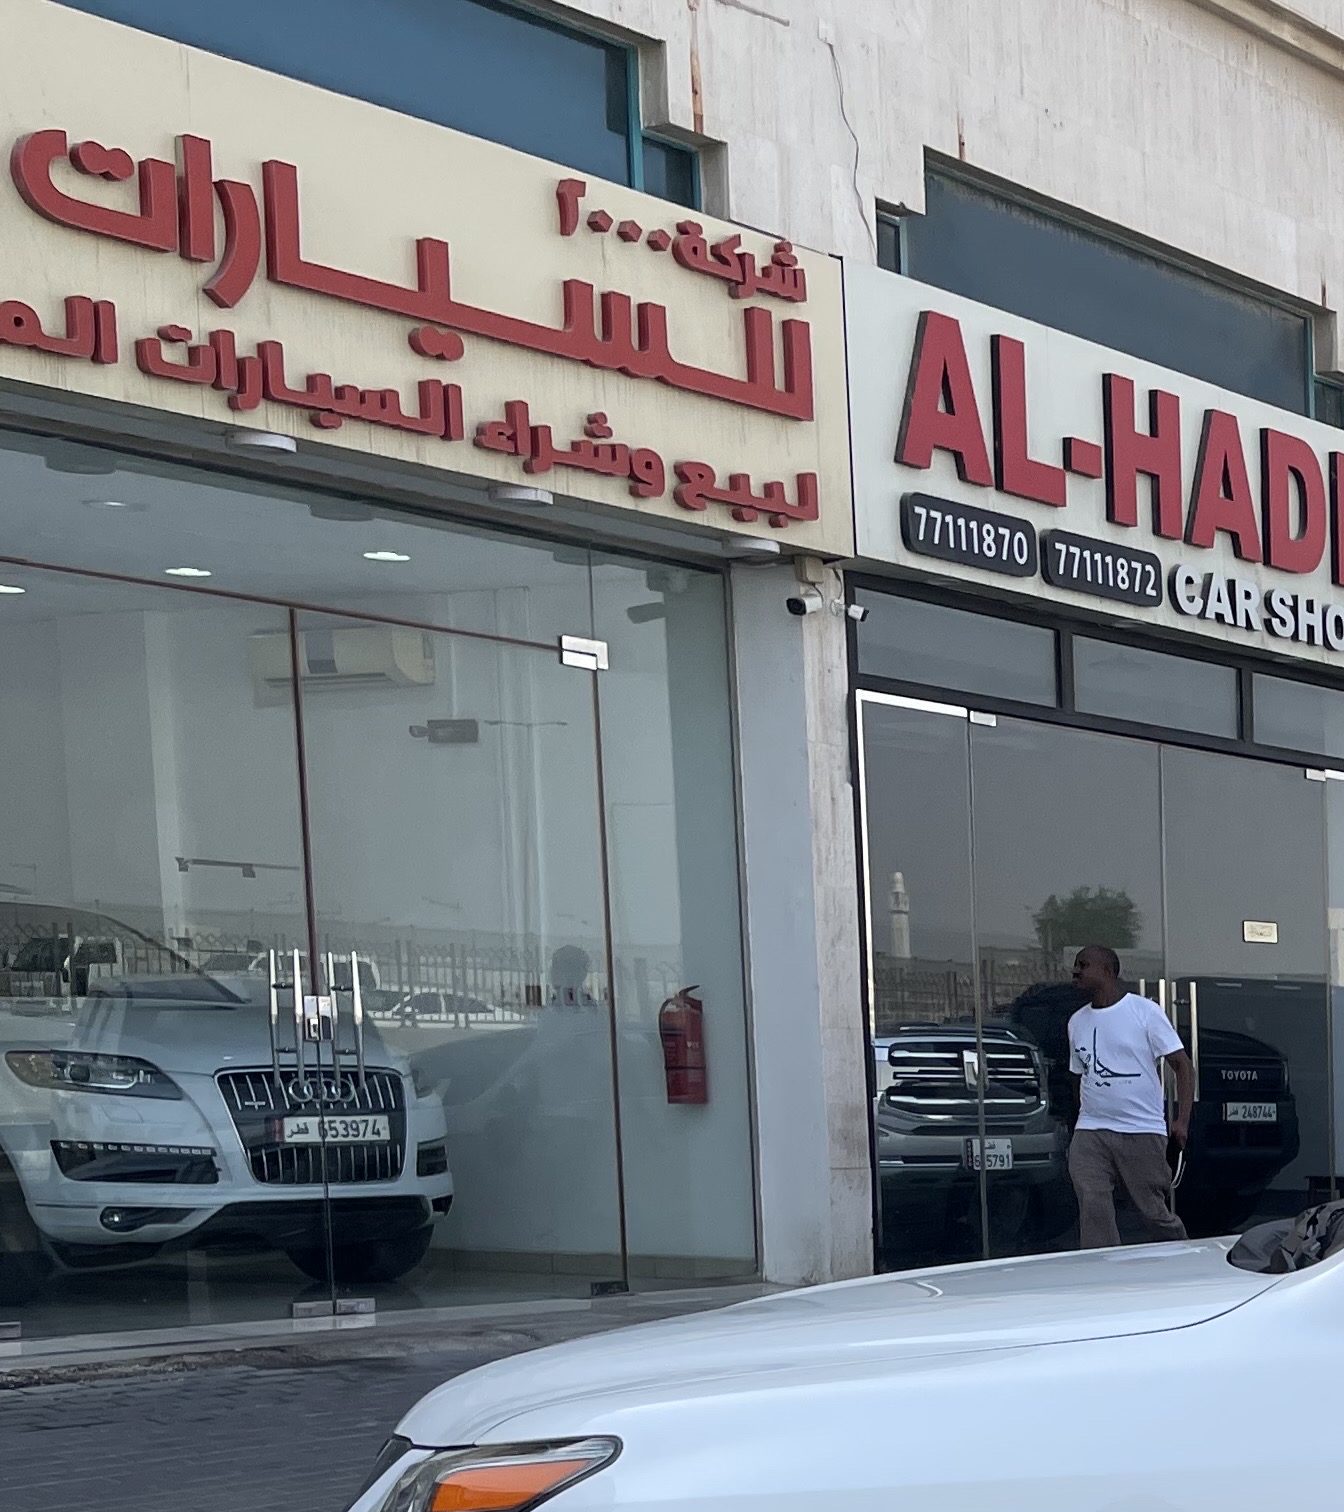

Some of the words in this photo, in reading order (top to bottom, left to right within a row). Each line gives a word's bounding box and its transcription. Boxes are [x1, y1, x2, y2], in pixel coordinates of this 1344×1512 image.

[10, 128, 816, 423] للسيارات
[672, 219, 808, 303] شركة
[135, 323, 464, 443] السيارات
[474, 400, 665, 499] وشراء
[673, 460, 820, 529] لبيع
[914, 505, 1029, 565] 77111870
[1054, 541, 1158, 597] 77111872
[1168, 564, 1263, 631] CAR
[1220, 1069, 1258, 1080] TOYOTA
[286, 1121, 310, 1138] قطر
[974, 1153, 1010, 1168] 65791
